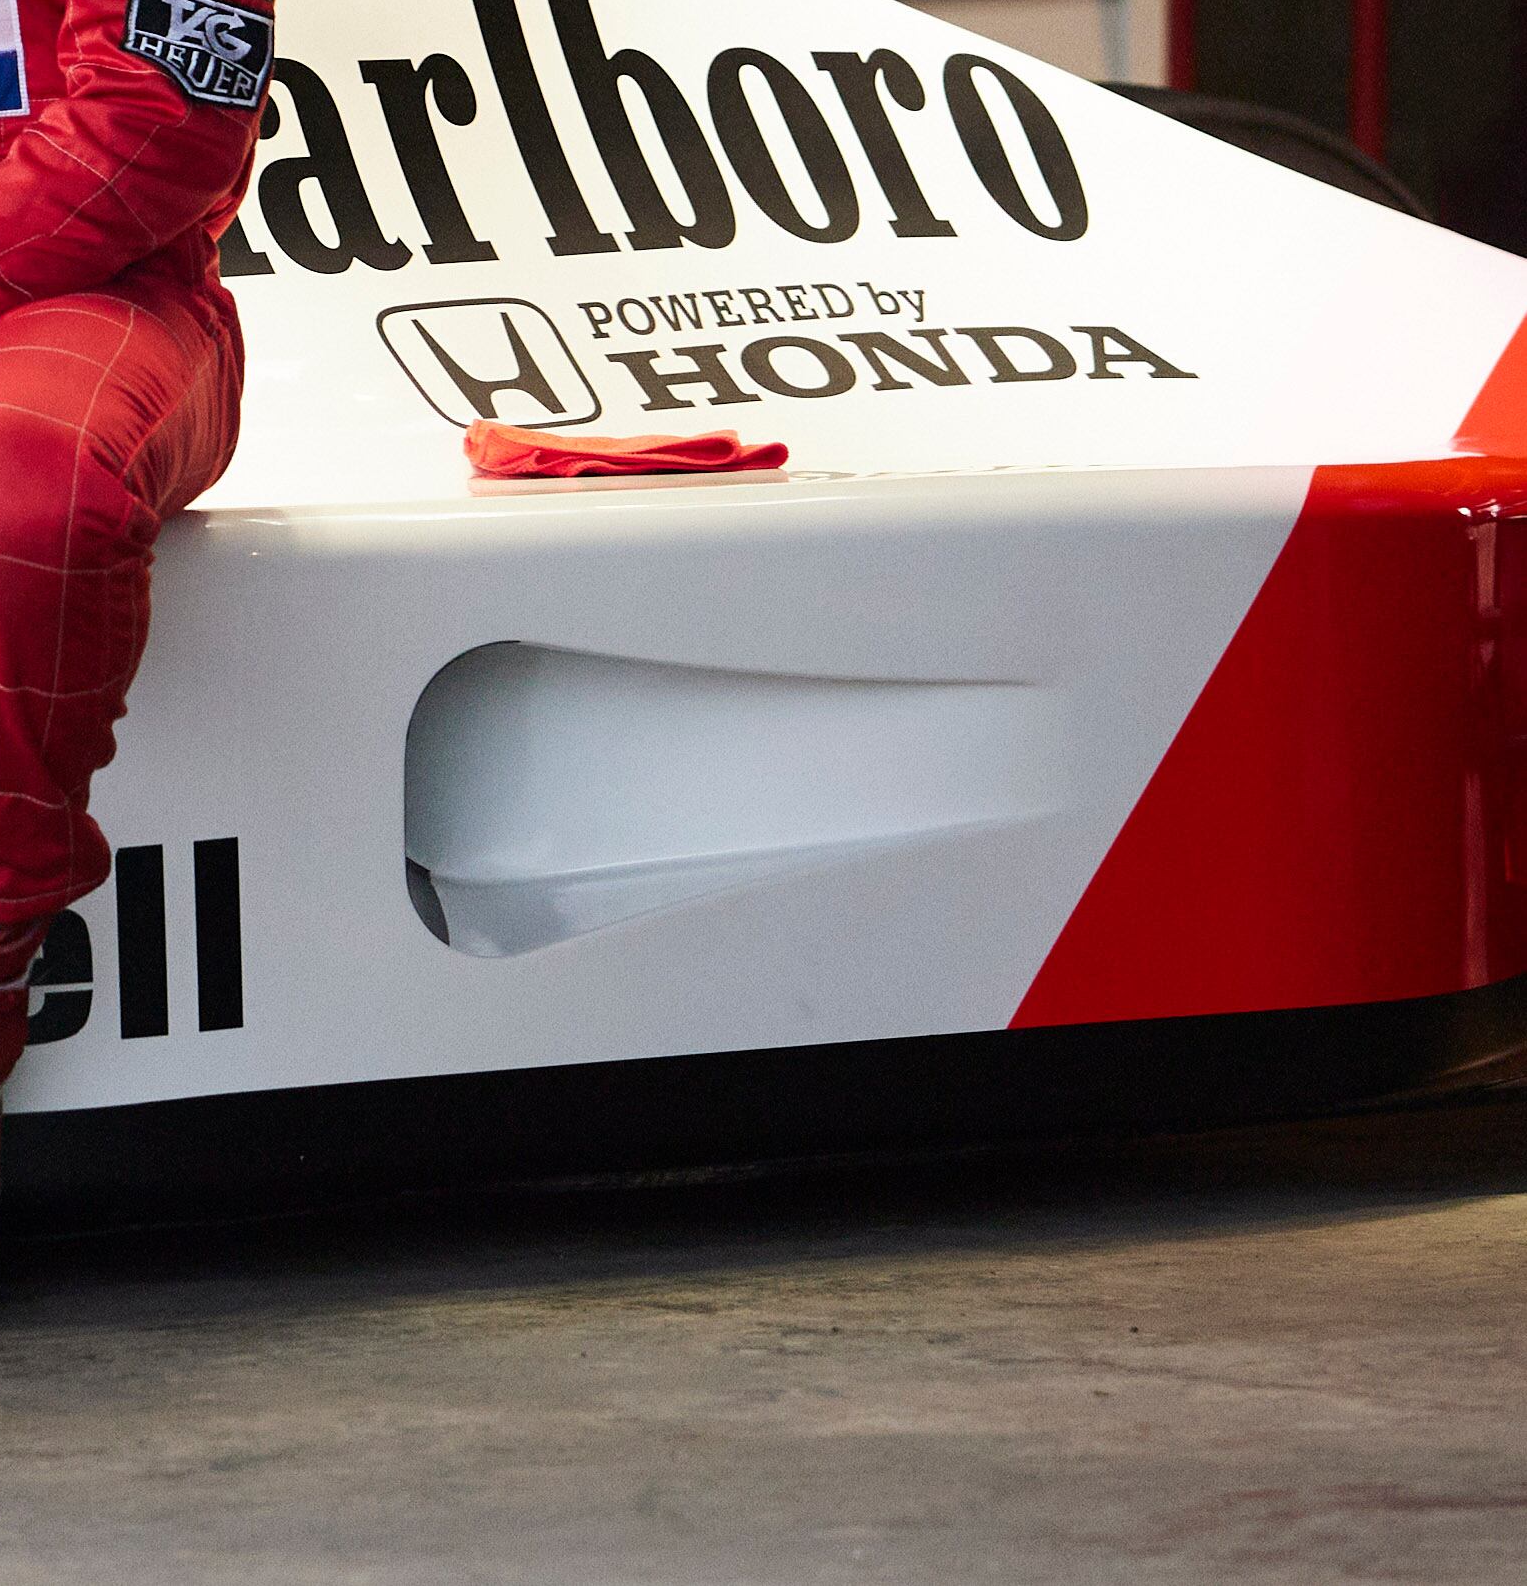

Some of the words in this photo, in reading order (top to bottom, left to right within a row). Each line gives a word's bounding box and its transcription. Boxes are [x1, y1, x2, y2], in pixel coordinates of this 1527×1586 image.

[138, 35, 253, 97] HEUER
[577, 283, 855, 339] POWERED
[857, 280, 926, 322] by
[604, 324, 1200, 411] HONDA
